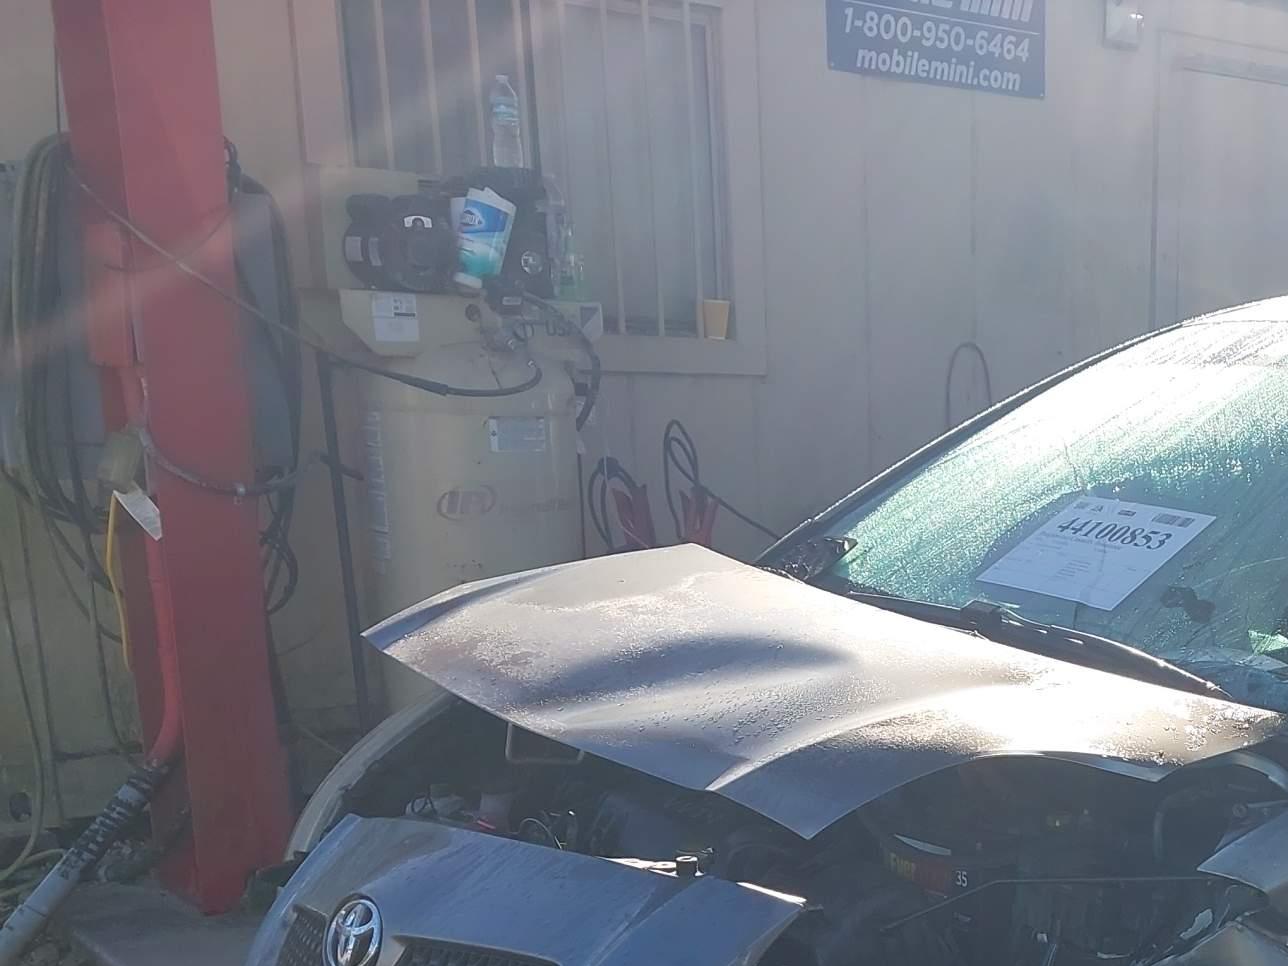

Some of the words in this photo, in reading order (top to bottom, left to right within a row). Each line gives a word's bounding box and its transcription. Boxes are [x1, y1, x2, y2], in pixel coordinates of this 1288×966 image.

[843, 7, 1030, 62] 1-800-950-6464
[856, 49, 1021, 91] mobilemini.com
[1057, 516, 1173, 551] 44100853
[955, 870, 968, 888] 35
